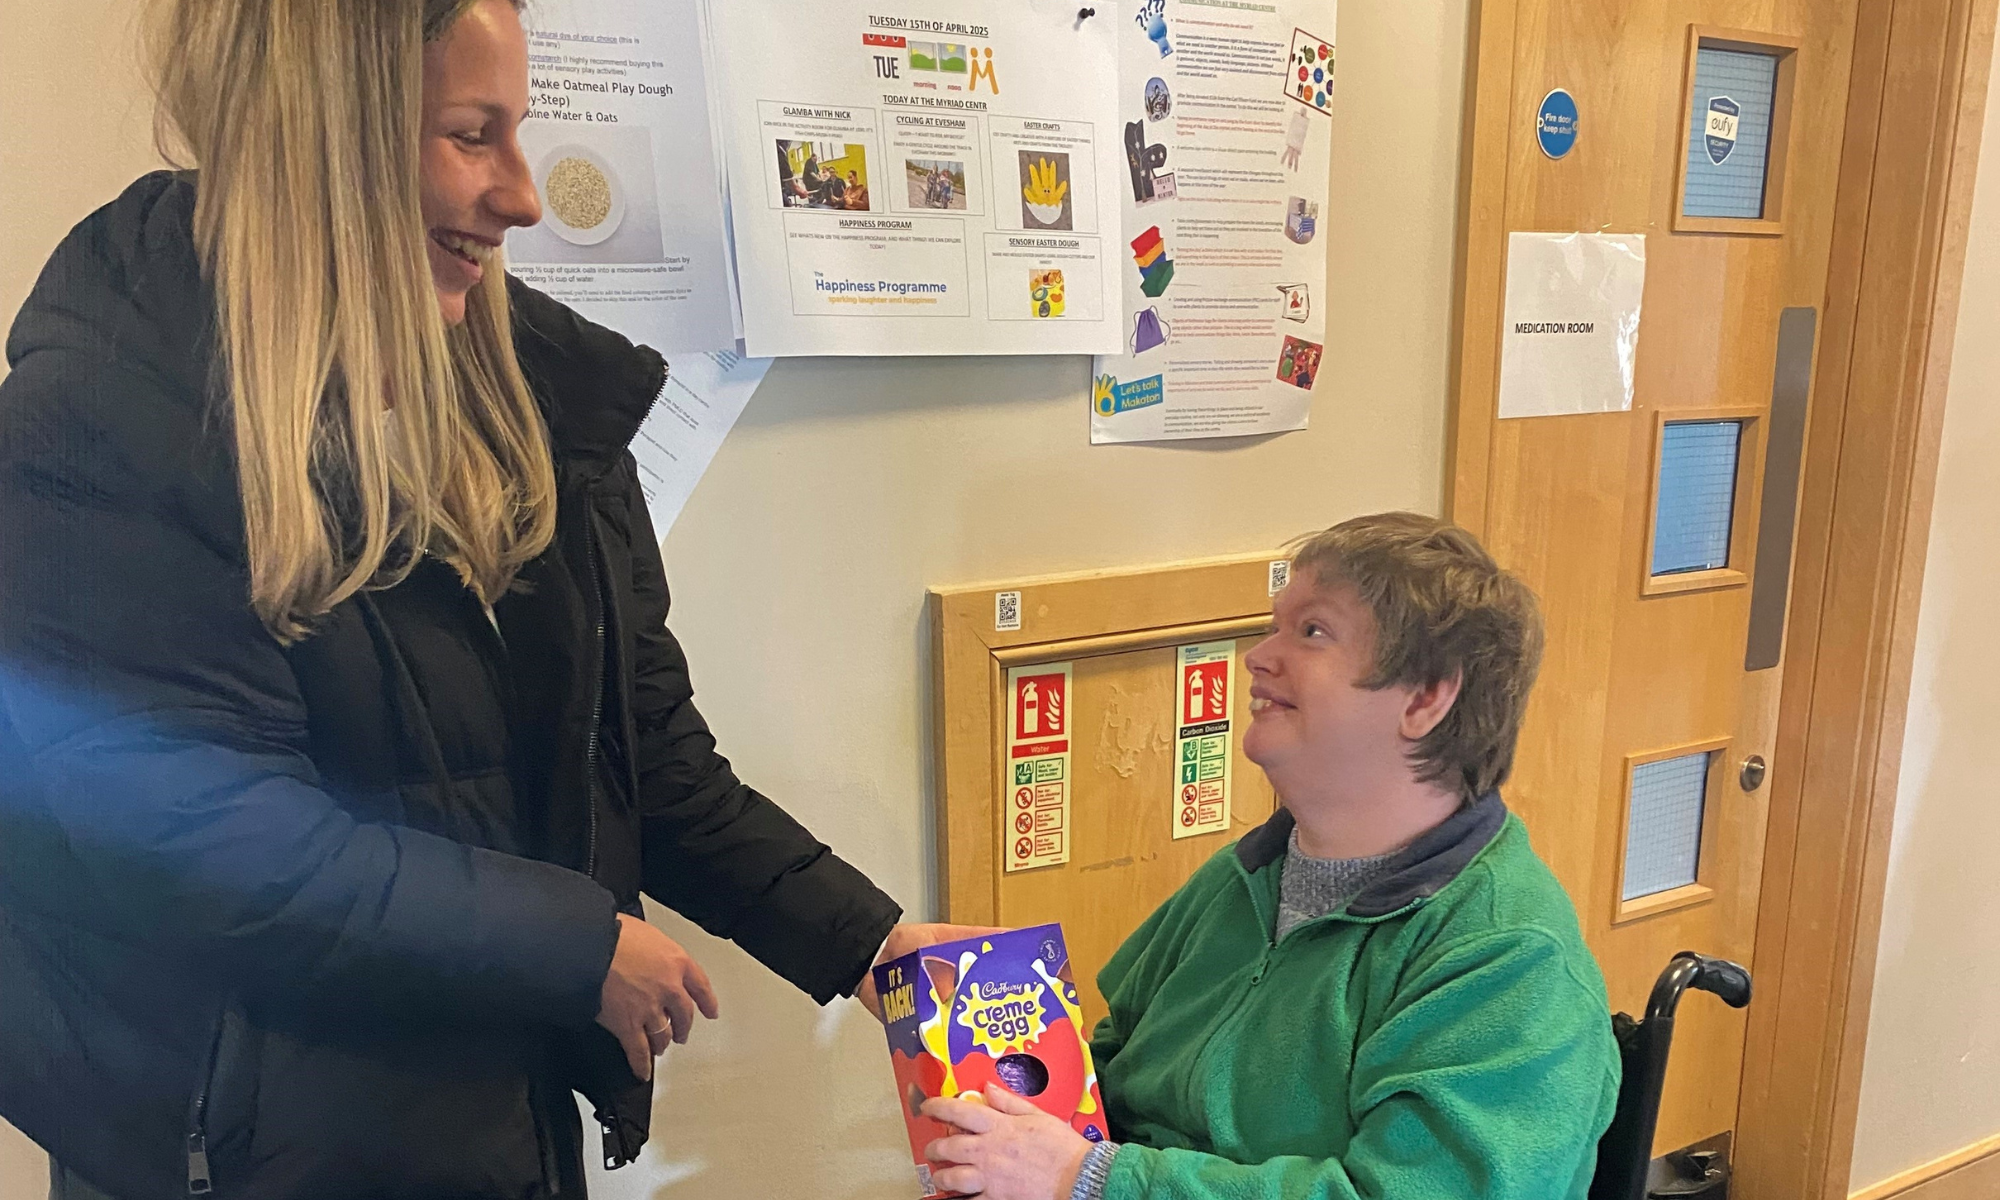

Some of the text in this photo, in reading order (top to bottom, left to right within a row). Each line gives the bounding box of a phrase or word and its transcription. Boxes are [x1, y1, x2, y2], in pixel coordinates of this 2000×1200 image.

[869, 15, 988, 36] TUESDAY 15TH OF APRIL 2025
[569, 57, 588, 66] highly
[590, 58, 628, 67] recommend
[629, 60, 651, 68] buying
[873, 56, 900, 79] TUE
[555, 65, 580, 74] sensory
[582, 66, 595, 74] play
[531, 78, 674, 97] Make Oatmeal Play Dough
[528, 94, 570, 108] y-Step)
[883, 94, 987, 110] TODAY AT THE MYRIAD CENTR
[552, 110, 582, 121] Water
[586, 112, 593, 122] &
[596, 112, 618, 123] Oats
[783, 107, 851, 119] GLAMBA WITH NICK
[1545, 112, 1572, 124] Fire door
[896, 116, 924, 125] CYCLING
[935, 118, 966, 127] EVESHAM
[1712, 117, 1733, 136] eufy
[1544, 124, 1572, 134] keep shut
[839, 220, 912, 230] HAPPINESS PROGRAM
[1009, 238, 1035, 246] SENSORY
[1058, 240, 1080, 248] DOUGH
[664, 256, 690, 265] Start by
[510, 267, 534, 276] pouring
[544, 267, 556, 276] cup
[564, 266, 581, 274] quick
[616, 266, 667, 274] microwave-safe
[668, 265, 684, 274] bowl
[525, 275, 546, 284] adding
[816, 280, 947, 294] Happiness Programme
[828, 296, 858, 304] sparking
[858, 296, 888, 304] laughter
[904, 297, 938, 305] happiness
[1515, 322, 1594, 334] MEDICATION ROOM
[1120, 382, 1142, 396] Let's
[1142, 380, 1160, 391] talk
[1122, 394, 1161, 410] Makaton
[1182, 724, 1227, 736] Carbon Dioxide
[1192, 742, 1197, 750] B
[1026, 763, 1032, 772] A
[982, 982, 1022, 998] Cadbury
[883, 983, 916, 1024] BACK!
[973, 1000, 1037, 1028] creme
[988, 1016, 1030, 1042] egg
